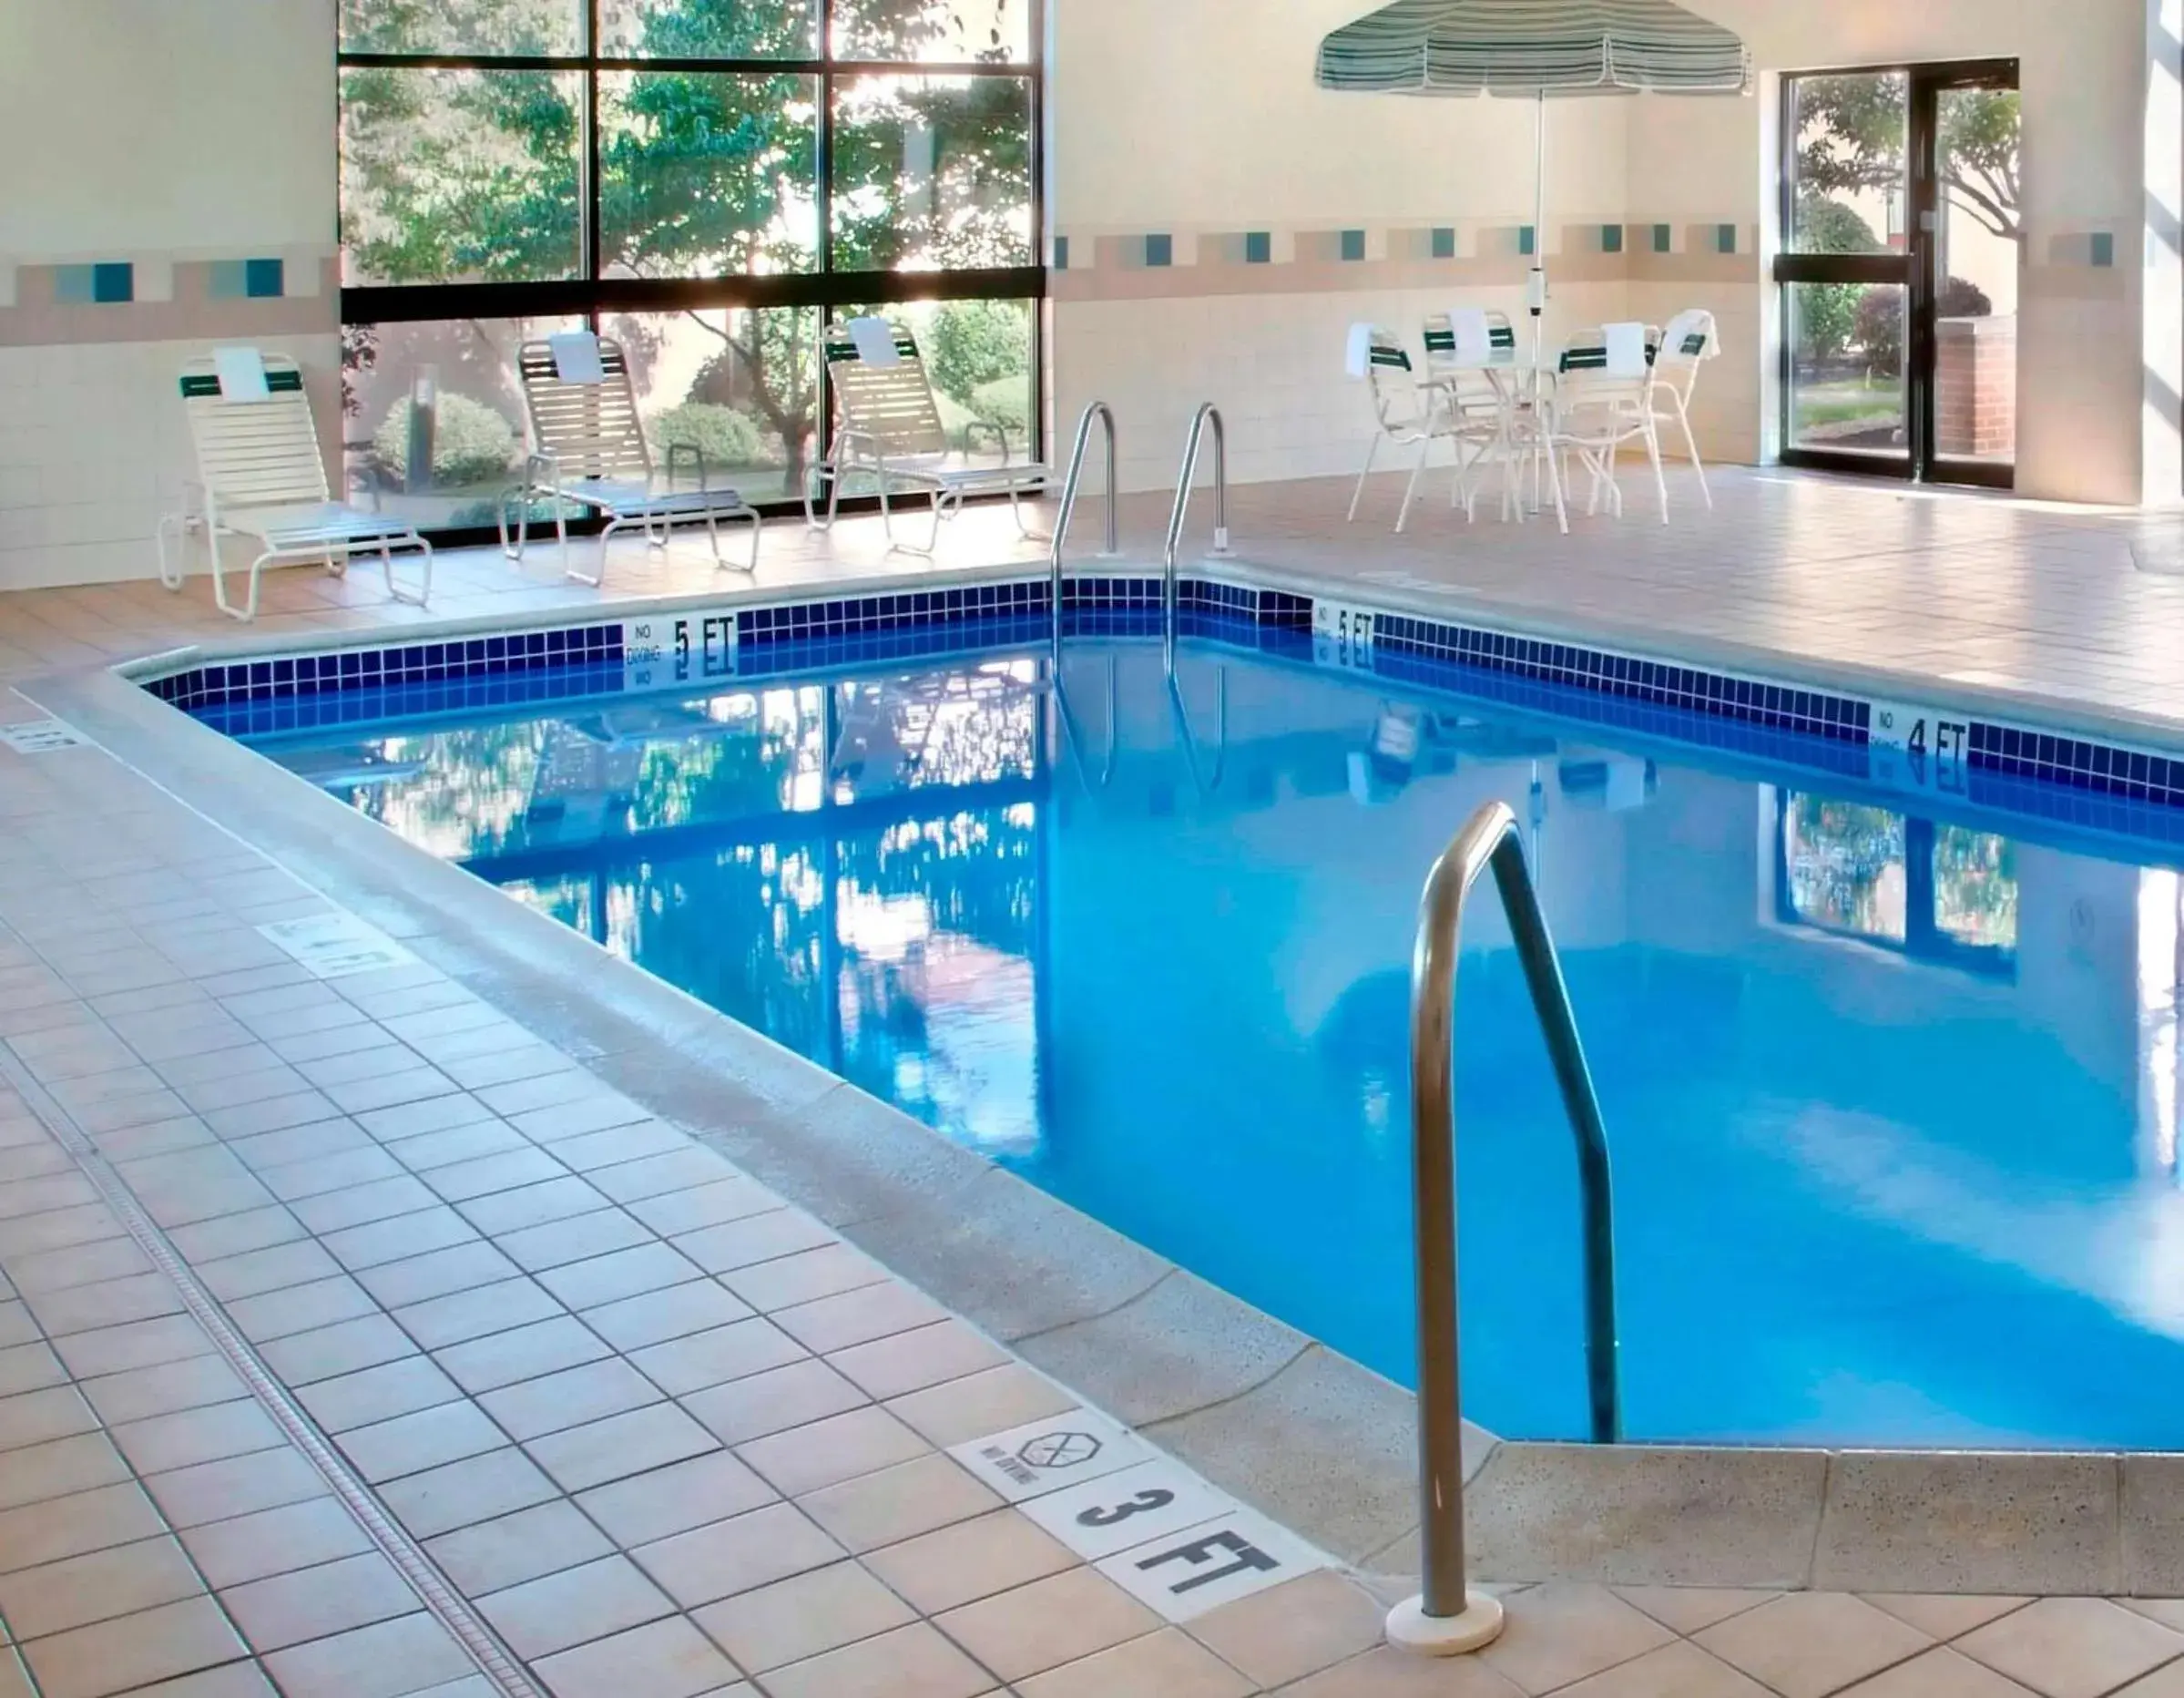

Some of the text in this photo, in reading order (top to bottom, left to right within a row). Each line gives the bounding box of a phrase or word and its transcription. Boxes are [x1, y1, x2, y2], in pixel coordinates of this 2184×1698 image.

[635, 624, 651, 639] NO
[672, 616, 734, 656] 5 FT
[1353, 612, 1373, 645] FT
[1878, 711, 1893, 729] NO
[1908, 718, 1966, 762] 4 FT
[1076, 1488, 1282, 1594] 3 FT
